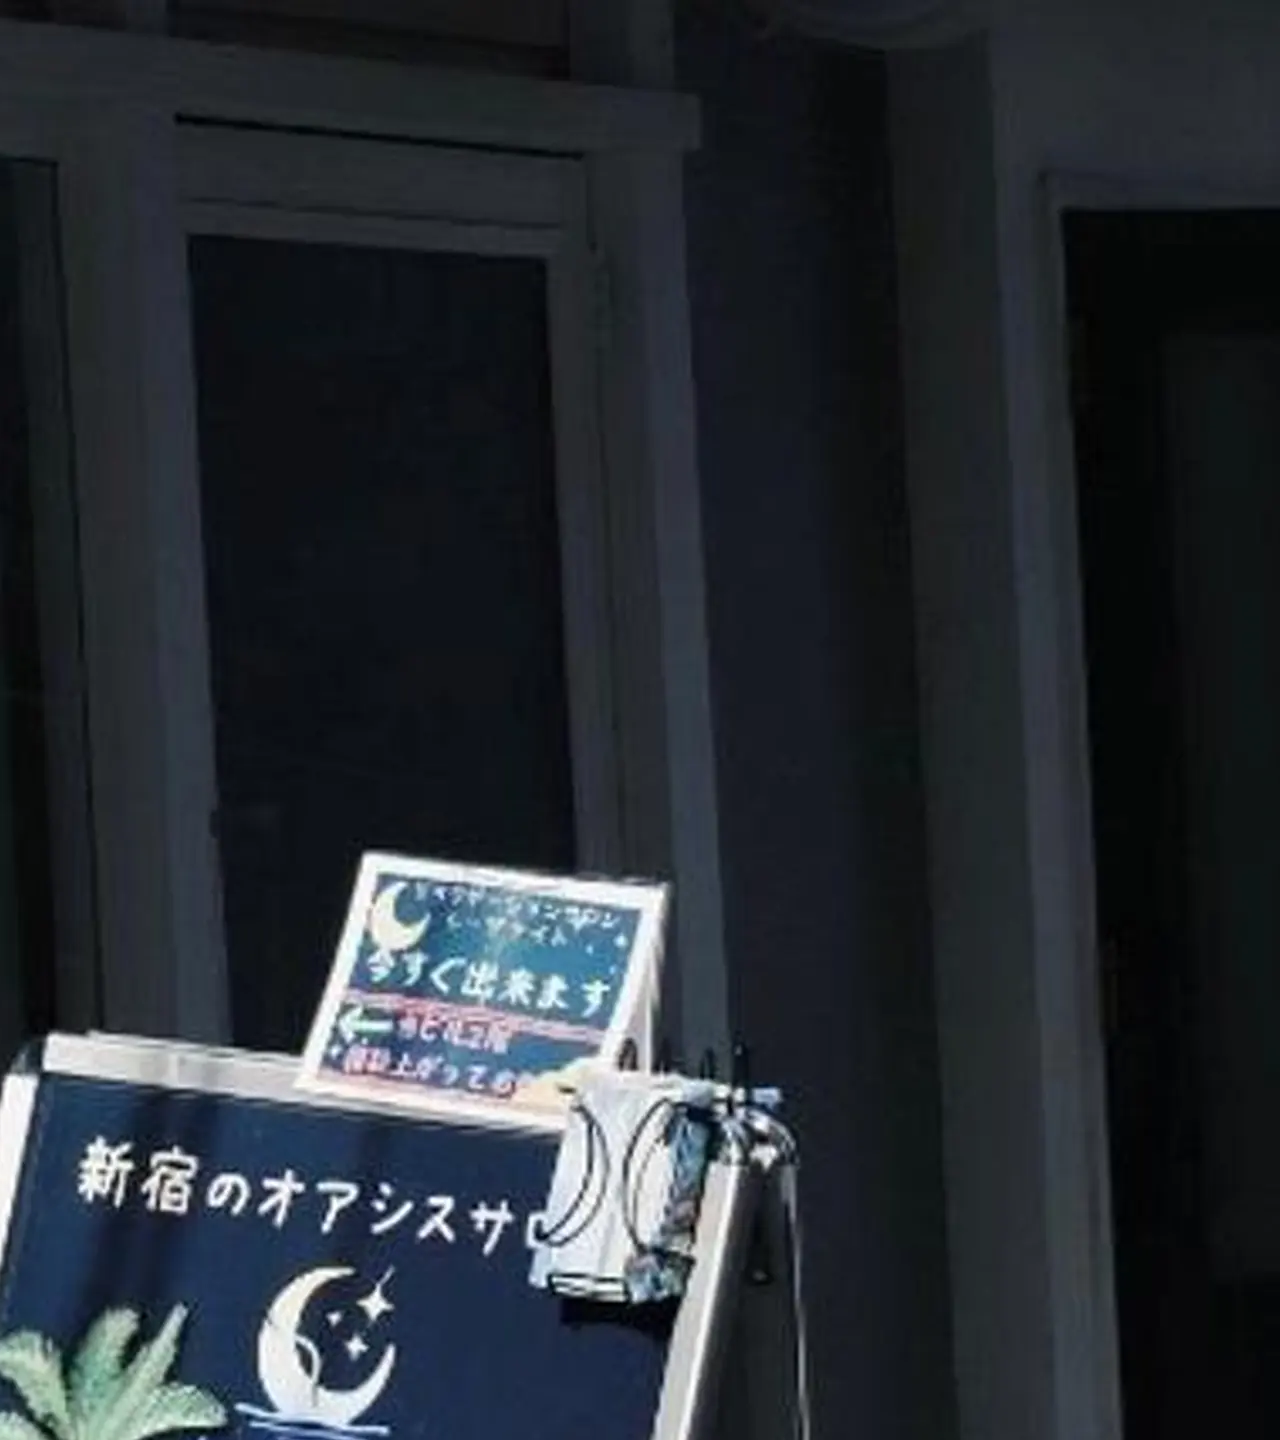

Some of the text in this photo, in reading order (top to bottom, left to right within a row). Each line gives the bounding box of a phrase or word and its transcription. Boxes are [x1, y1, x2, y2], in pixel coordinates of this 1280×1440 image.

[366, 950, 611, 1019] 今すぐ出来ます
